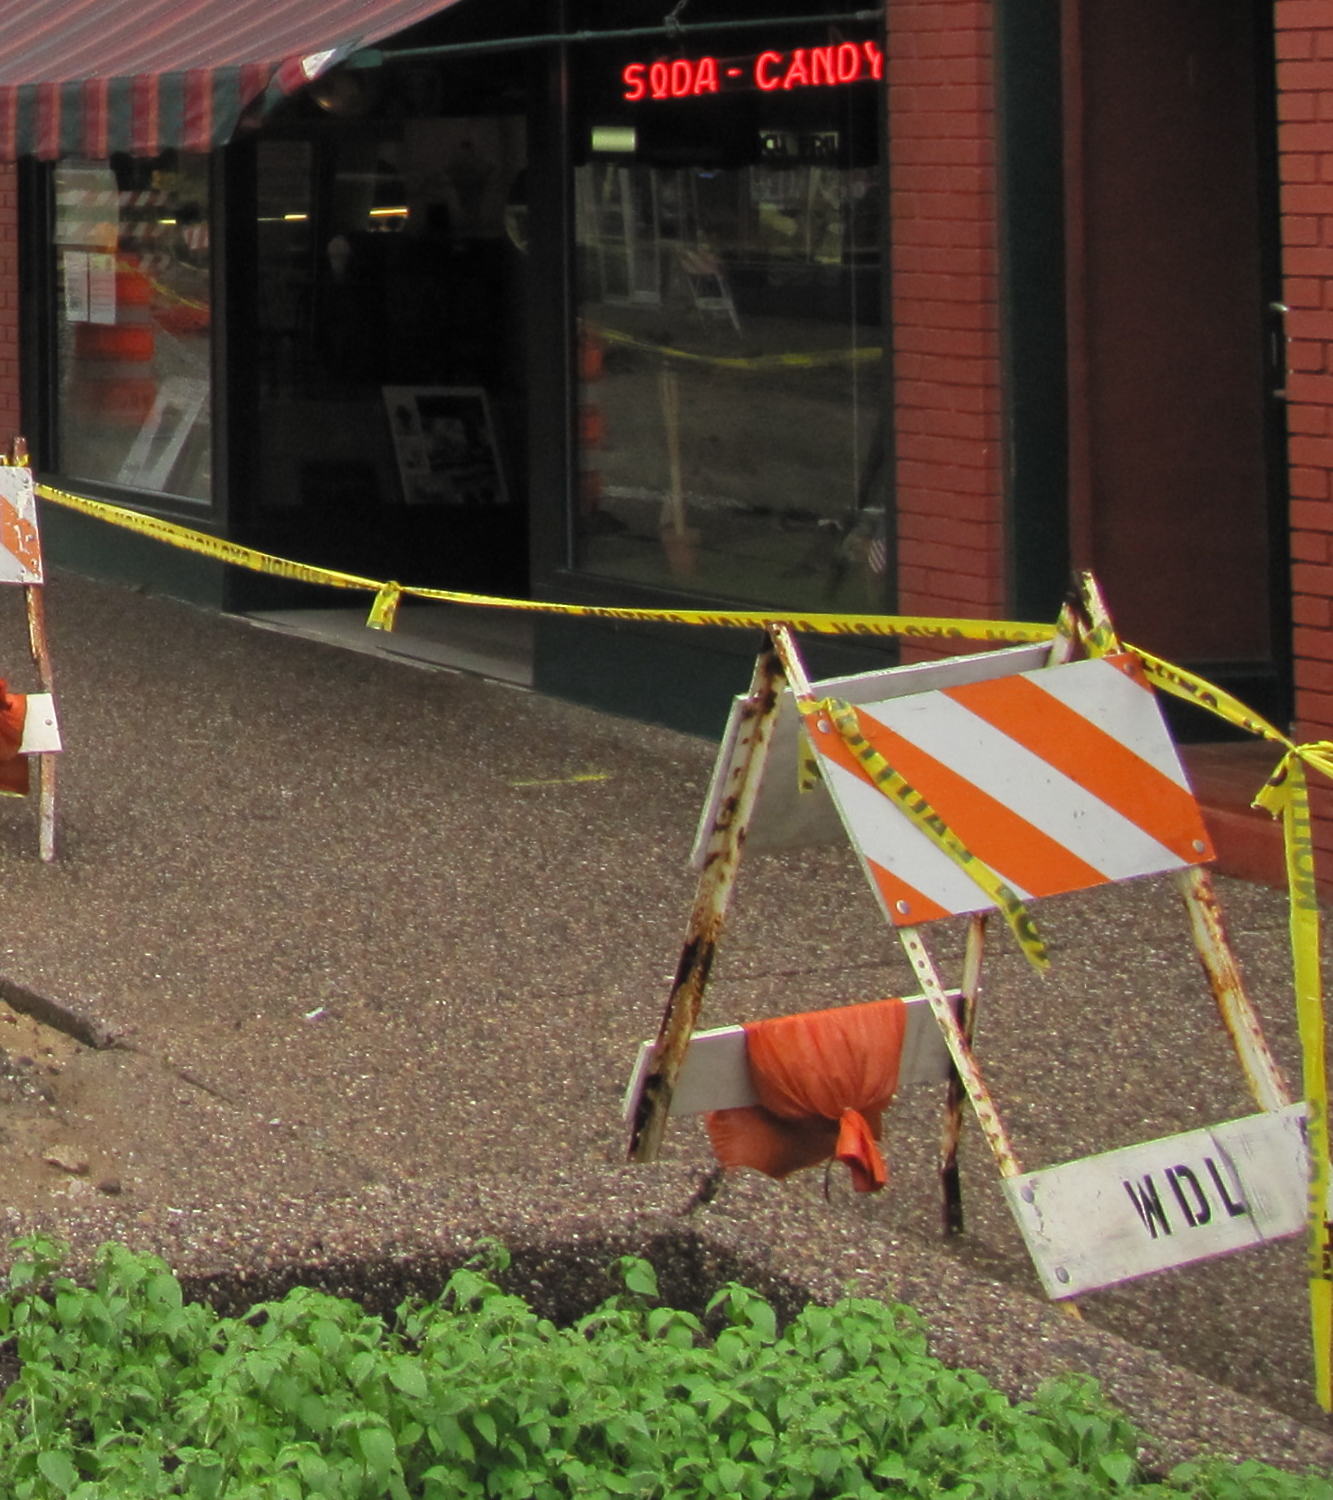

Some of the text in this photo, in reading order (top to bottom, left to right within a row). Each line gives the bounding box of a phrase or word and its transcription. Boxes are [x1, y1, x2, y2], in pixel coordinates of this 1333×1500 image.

[621, 56, 719, 101] SODA
[755, 41, 881, 91] CANDY
[1123, 1156, 1247, 1240] WDL
